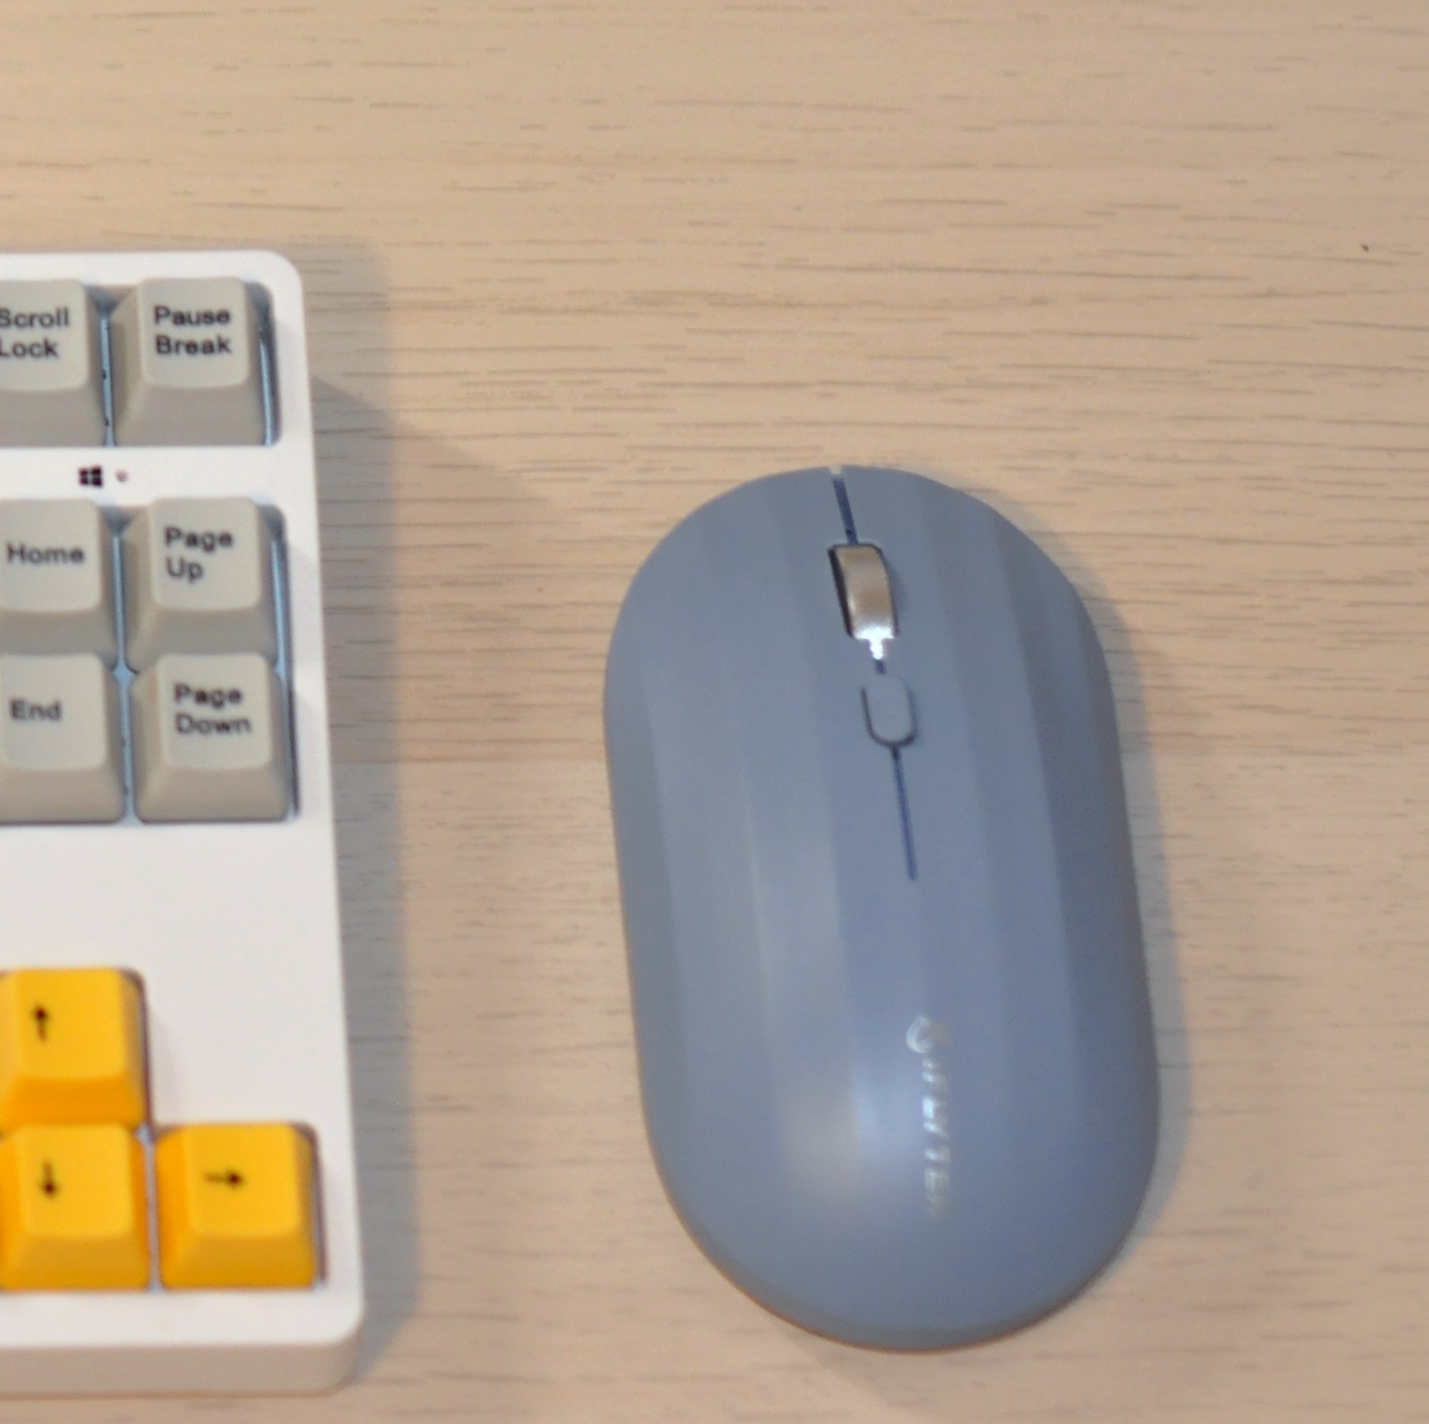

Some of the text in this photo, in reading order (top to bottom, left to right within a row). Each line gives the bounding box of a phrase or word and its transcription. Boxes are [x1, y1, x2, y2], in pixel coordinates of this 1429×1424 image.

[153, 304, 232, 327] Pause
[154, 333, 231, 356] Break
[163, 525, 234, 554] Page
[5, 542, 86, 566] Home
[165, 556, 205, 584] Up
[173, 682, 243, 711] Page
[8, 697, 63, 722] End
[174, 711, 251, 736] Down
